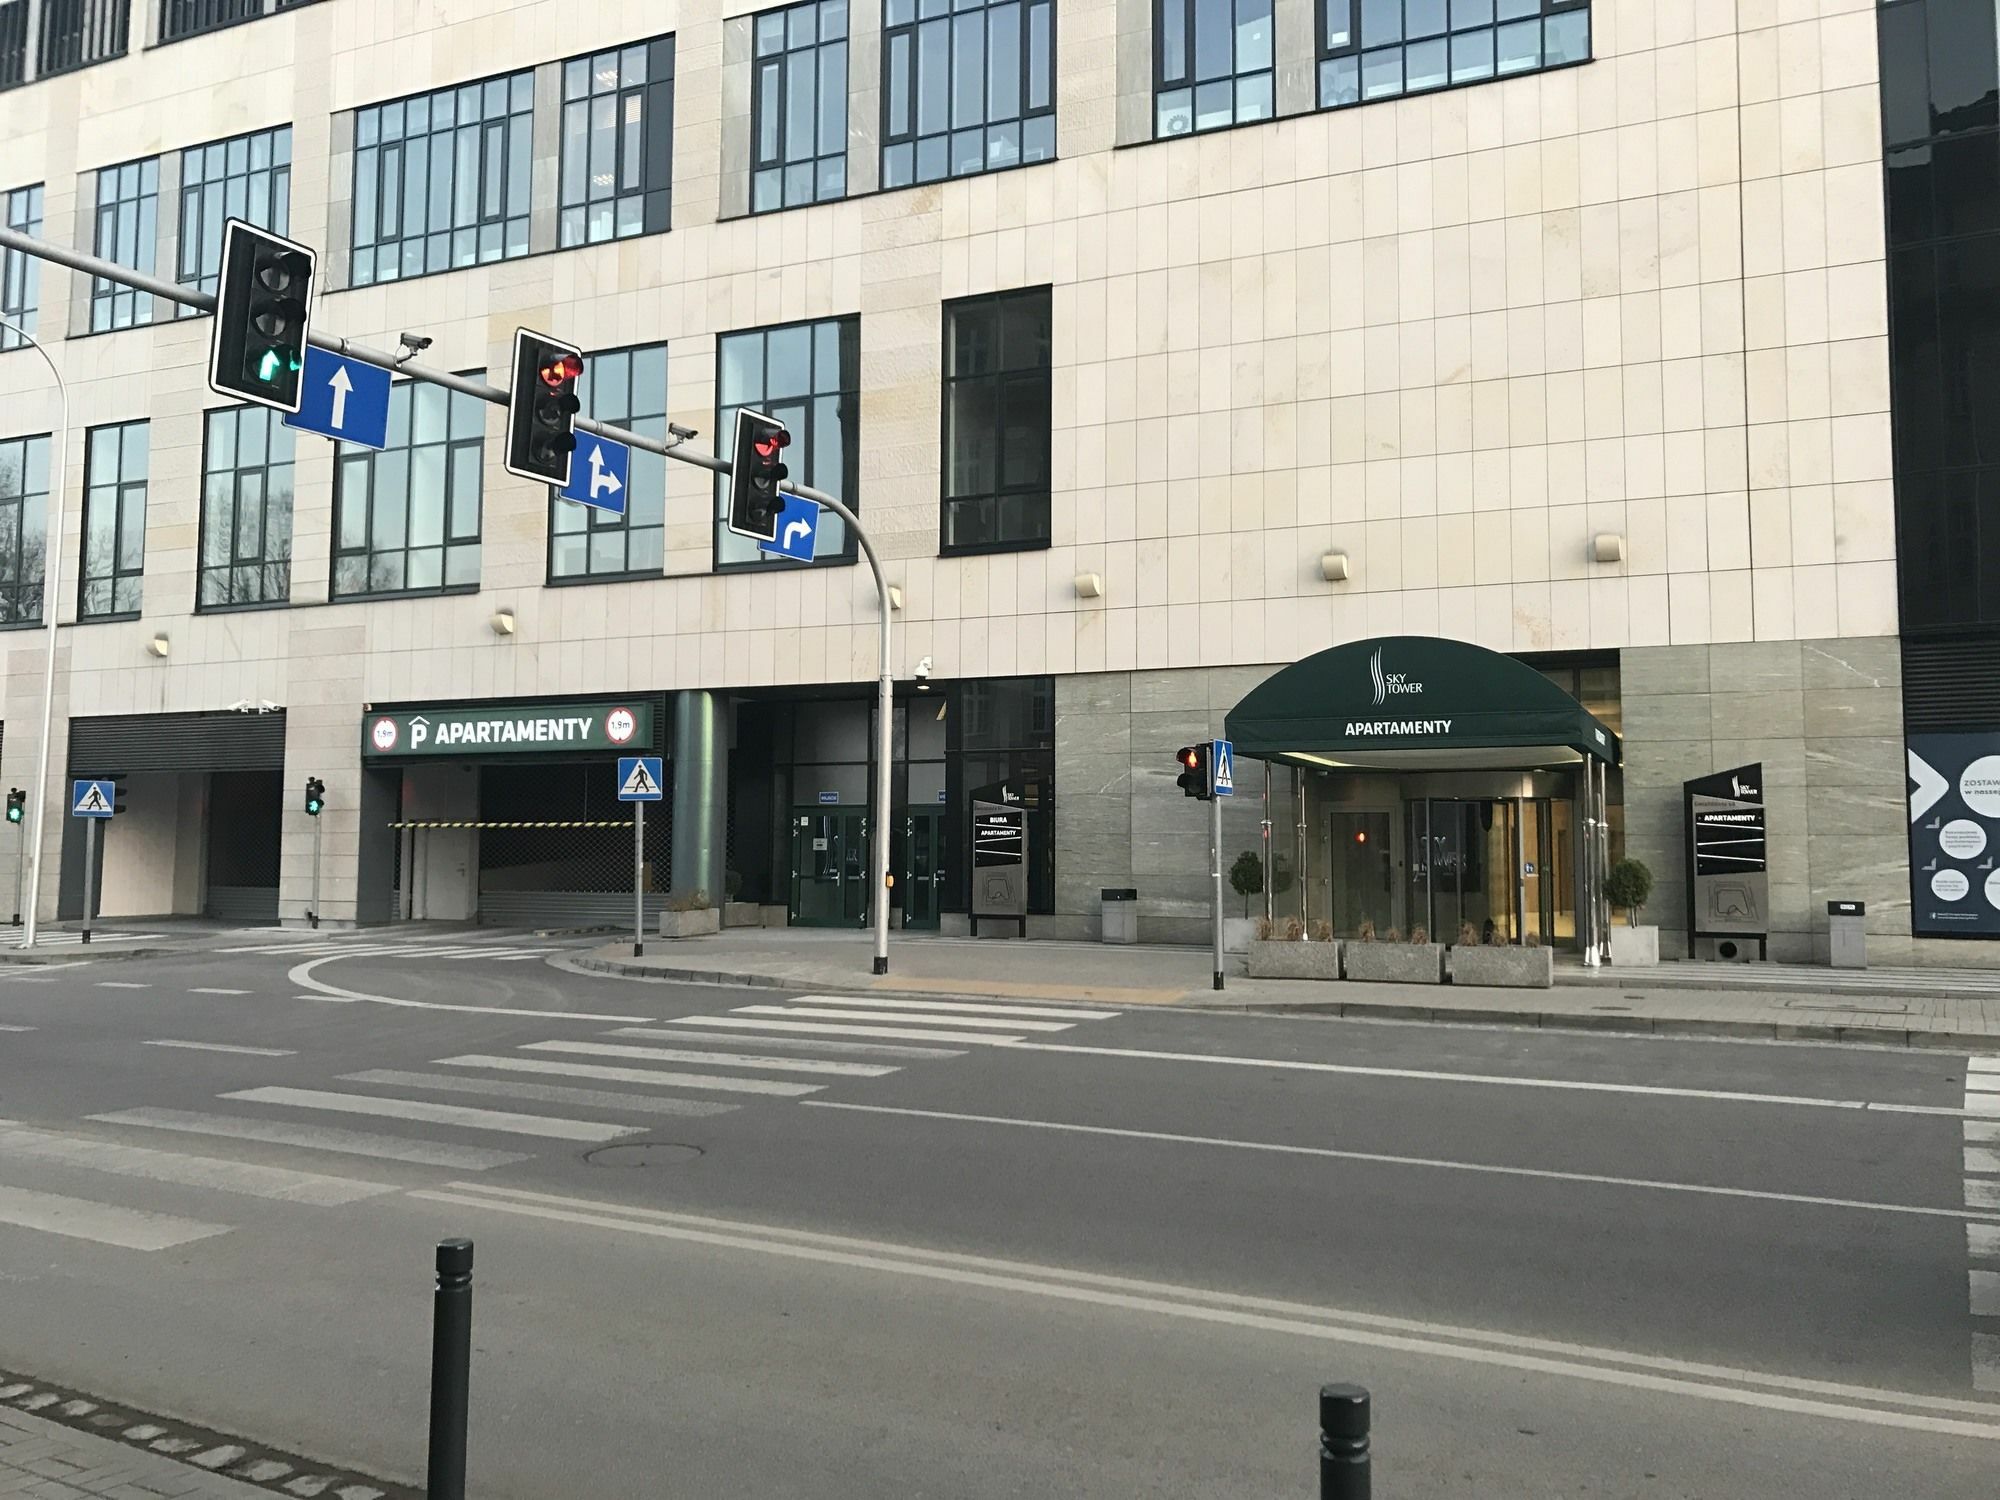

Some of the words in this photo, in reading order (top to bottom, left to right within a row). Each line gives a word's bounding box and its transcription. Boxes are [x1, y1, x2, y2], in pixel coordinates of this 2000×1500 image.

[1386, 673, 1406, 684] SKY
[1387, 683, 1422, 694] TOWER
[435, 717, 592, 744] APARTAMENTY
[1345, 720, 1451, 735] APARTAMENTY
